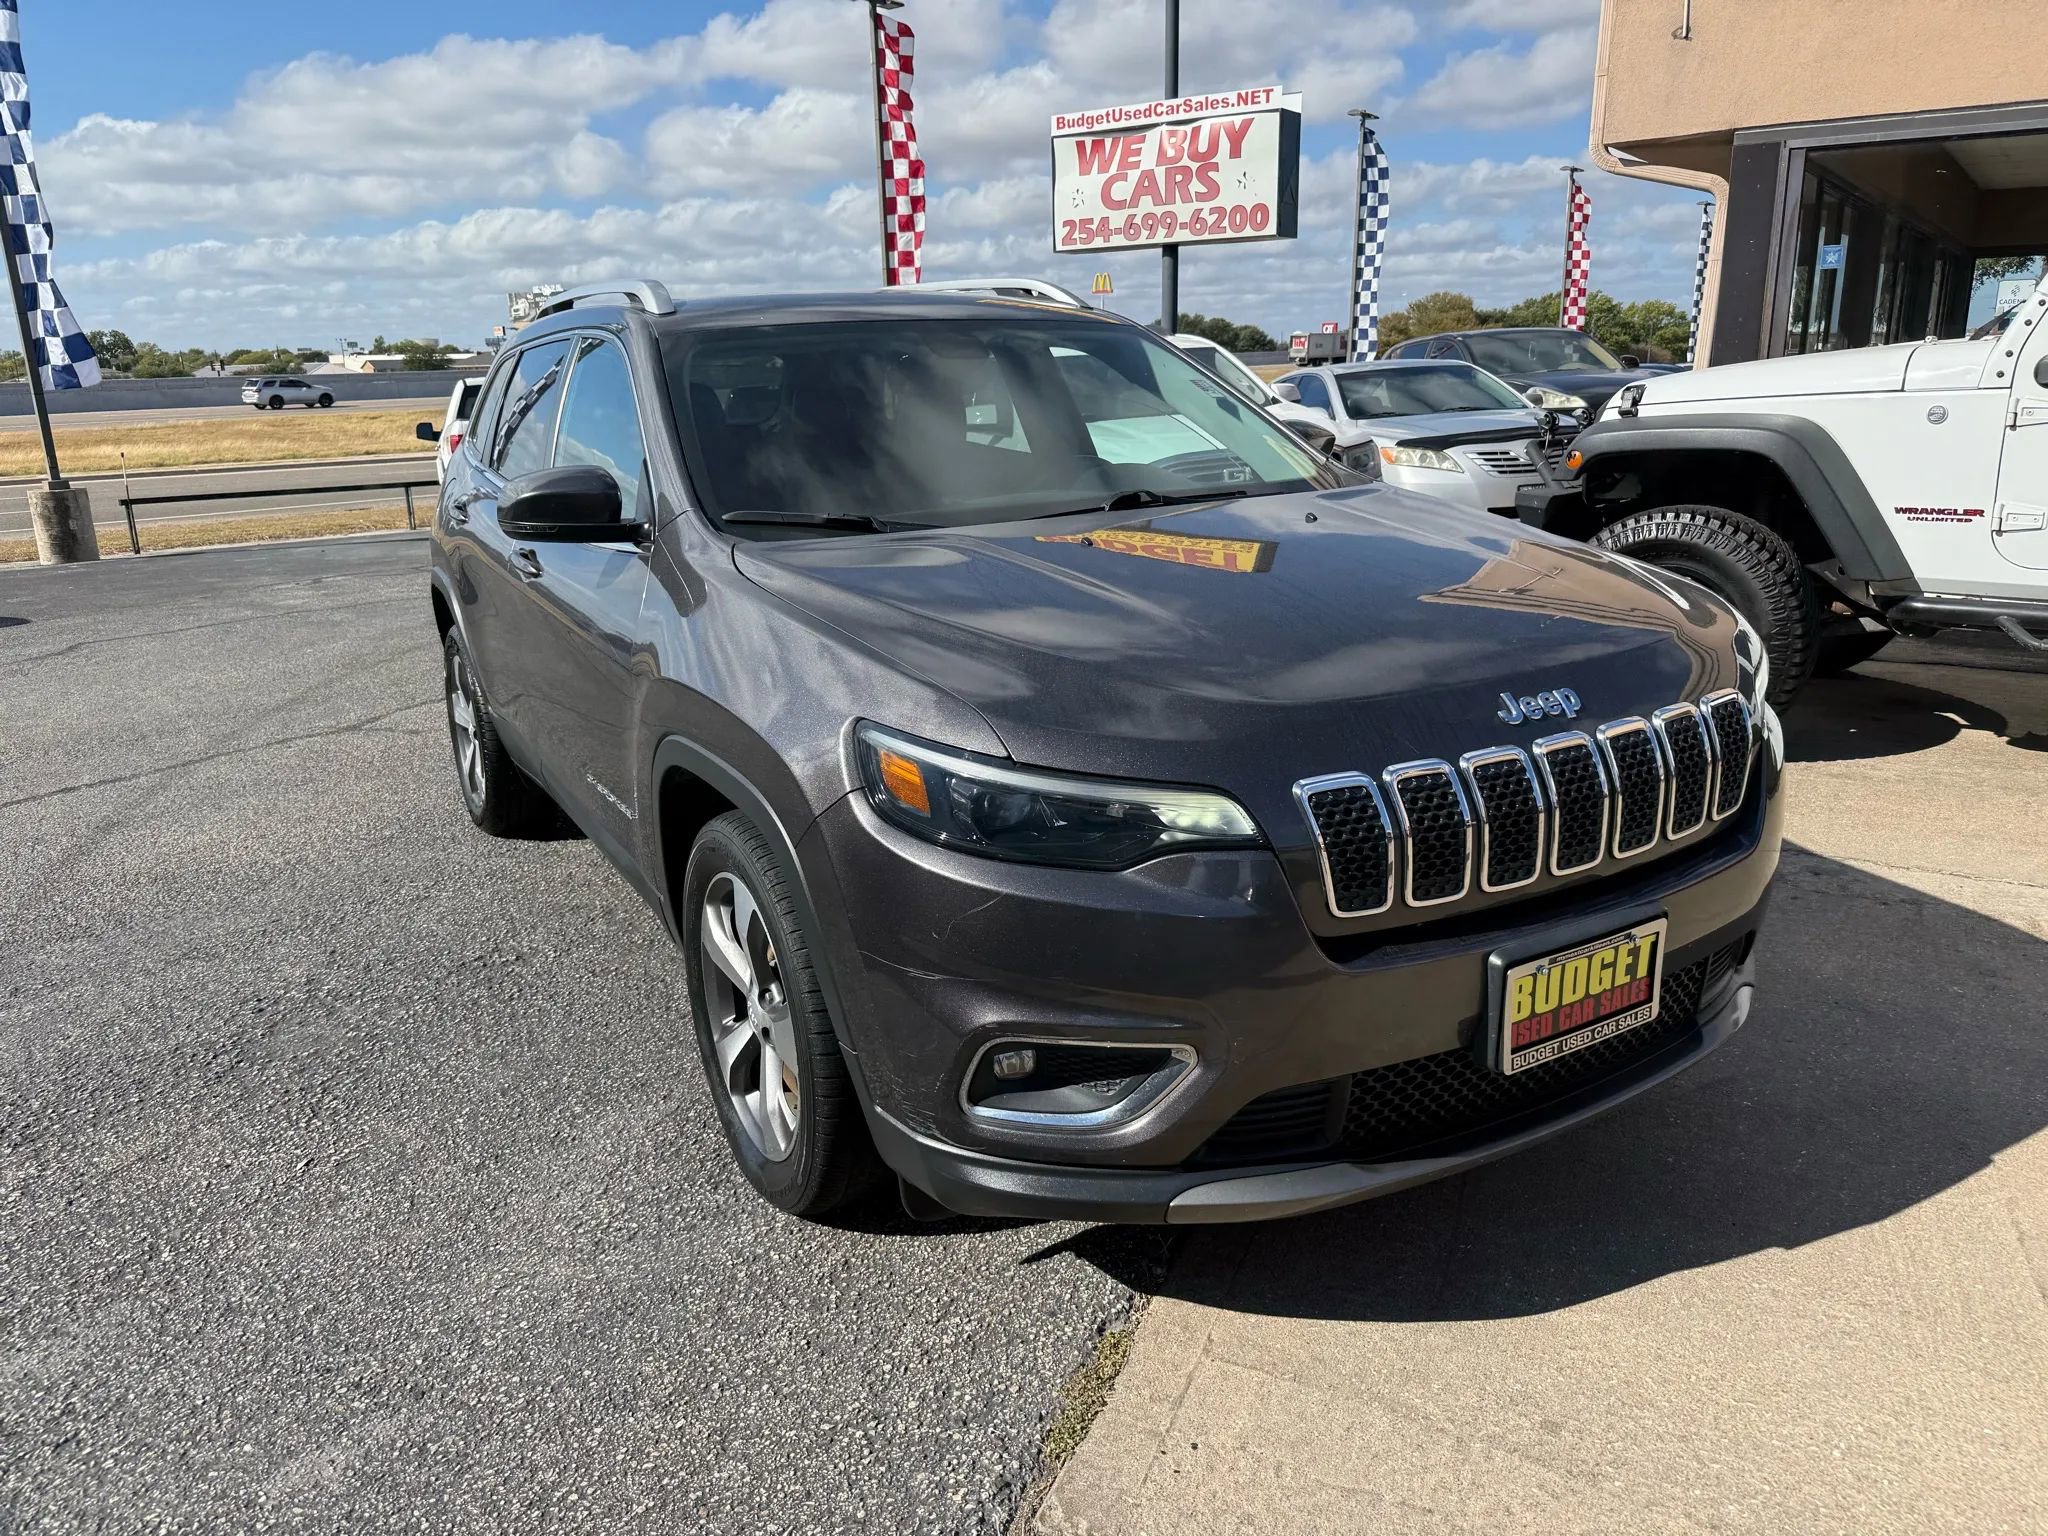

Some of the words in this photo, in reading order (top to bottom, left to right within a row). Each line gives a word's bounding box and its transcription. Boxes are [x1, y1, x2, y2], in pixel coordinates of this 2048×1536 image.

[1056, 88, 1274, 131] BudgetUsedCarSales.NET
[1075, 134, 1147, 177] WE
[1155, 117, 1255, 168] BUY
[1100, 161, 1220, 211] CARS
[1061, 202, 1270, 247] 254-699-6200
[1894, 506, 1985, 517] WRANGLER
[1497, 687, 1582, 725] Jeep
[1511, 934, 1657, 1023] BUDGET
[1559, 998, 1594, 1031] CAR
[1600, 977, 1650, 1016] SALES
[1513, 1043, 1560, 1070] BUDGET
[1562, 1032, 1592, 1051] USED
[1594, 1021, 1616, 1038] CAR
[1618, 1008, 1651, 1030] SALES
